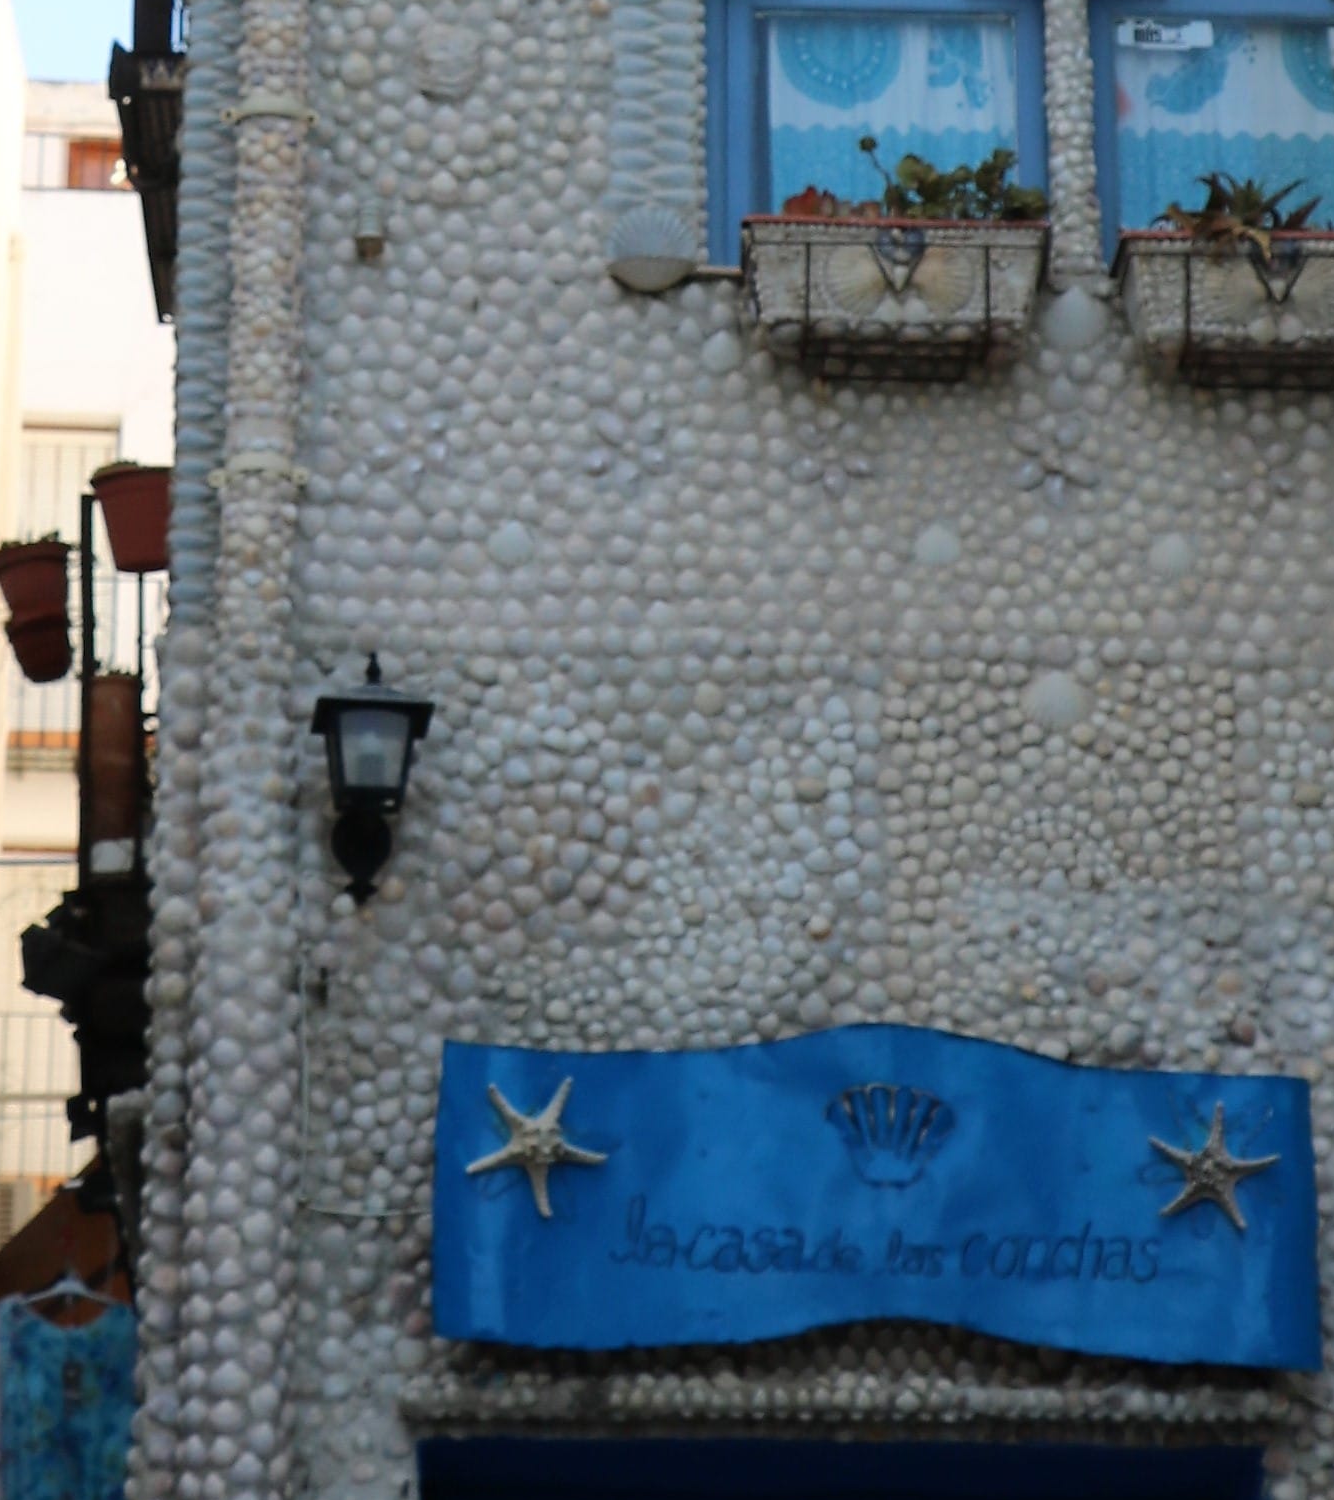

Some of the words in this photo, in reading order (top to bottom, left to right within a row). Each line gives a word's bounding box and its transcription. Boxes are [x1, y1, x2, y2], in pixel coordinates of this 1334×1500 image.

[685, 1223, 807, 1274] casa
[886, 1231, 945, 1276] las
[960, 1221, 1161, 1284] conchas
